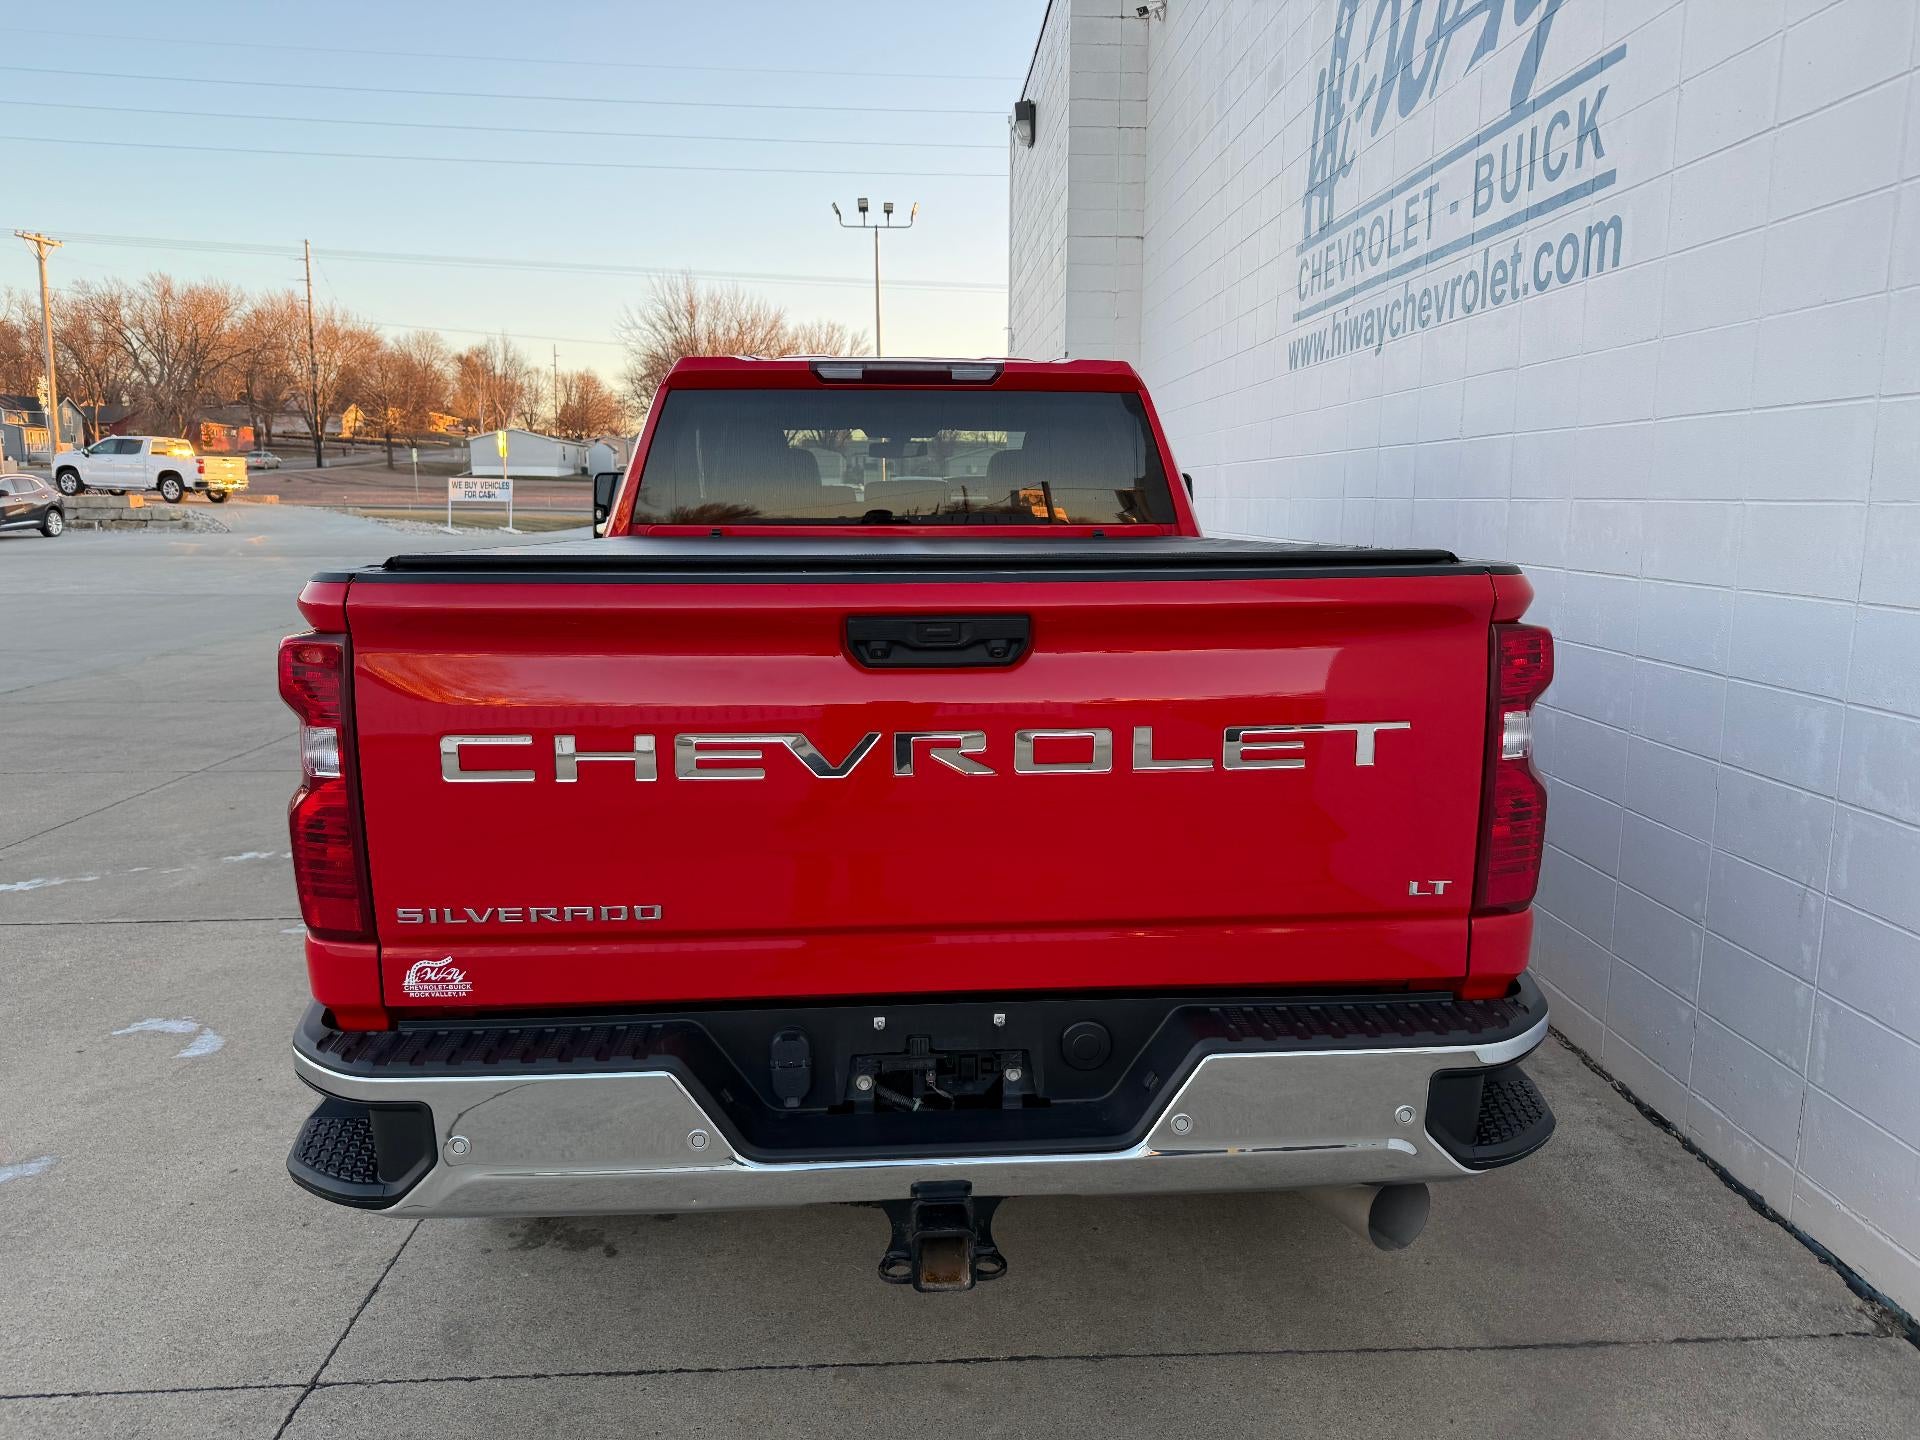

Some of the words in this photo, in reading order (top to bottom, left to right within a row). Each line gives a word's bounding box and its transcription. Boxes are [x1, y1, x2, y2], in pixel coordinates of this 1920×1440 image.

[1298, 182, 1440, 302] CHEVROLET
[1472, 84, 1610, 219] BUICK
[1288, 214, 1623, 371] www.hiwaychevrolet.com
[451, 481, 463, 489] WE
[464, 481, 478, 490] BUY
[480, 481, 510, 490] VEHICLES
[464, 490, 477, 499] FOR
[440, 721, 1411, 783] CHEVROLET
[1408, 879, 1453, 896] LT
[396, 904, 662, 924] SILVERADO
